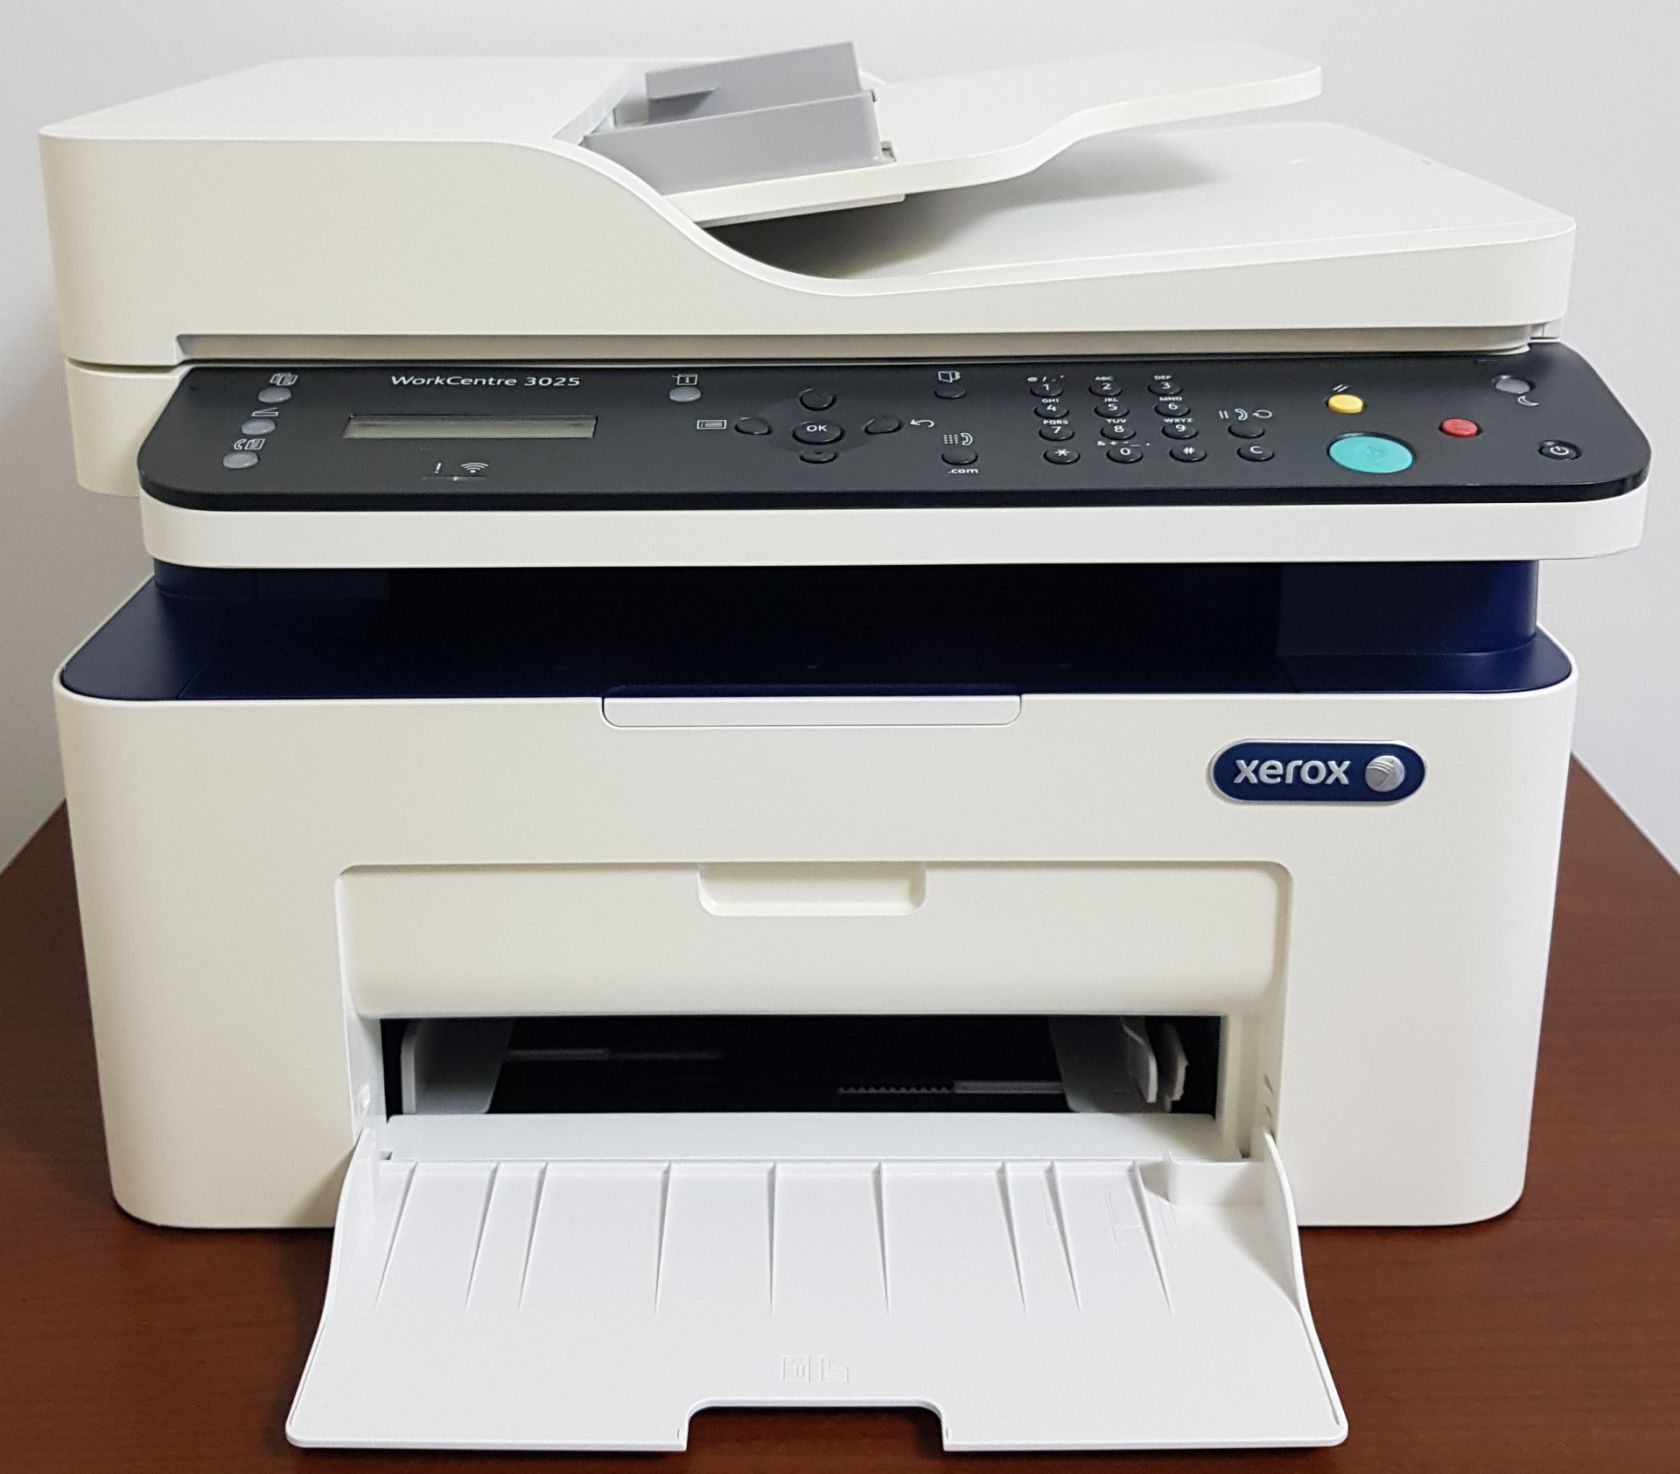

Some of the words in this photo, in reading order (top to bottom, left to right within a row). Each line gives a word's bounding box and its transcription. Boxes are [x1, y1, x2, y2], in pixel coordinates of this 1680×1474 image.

[391, 375, 517, 386] WorkCentre
[524, 376, 580, 386] 3025
[1042, 383, 1050, 391] 1
[1102, 382, 1112, 390] 2
[1161, 381, 1171, 389] 3
[1107, 403, 1118, 411] 5
[1167, 402, 1178, 410] 6
[806, 424, 828, 433] OK
[1052, 426, 1062, 434] 7
[1114, 425, 1124, 433] 8
[1175, 424, 1186, 432] 9
[1249, 445, 1264, 454] C
[1233, 759, 1351, 785] xerox
